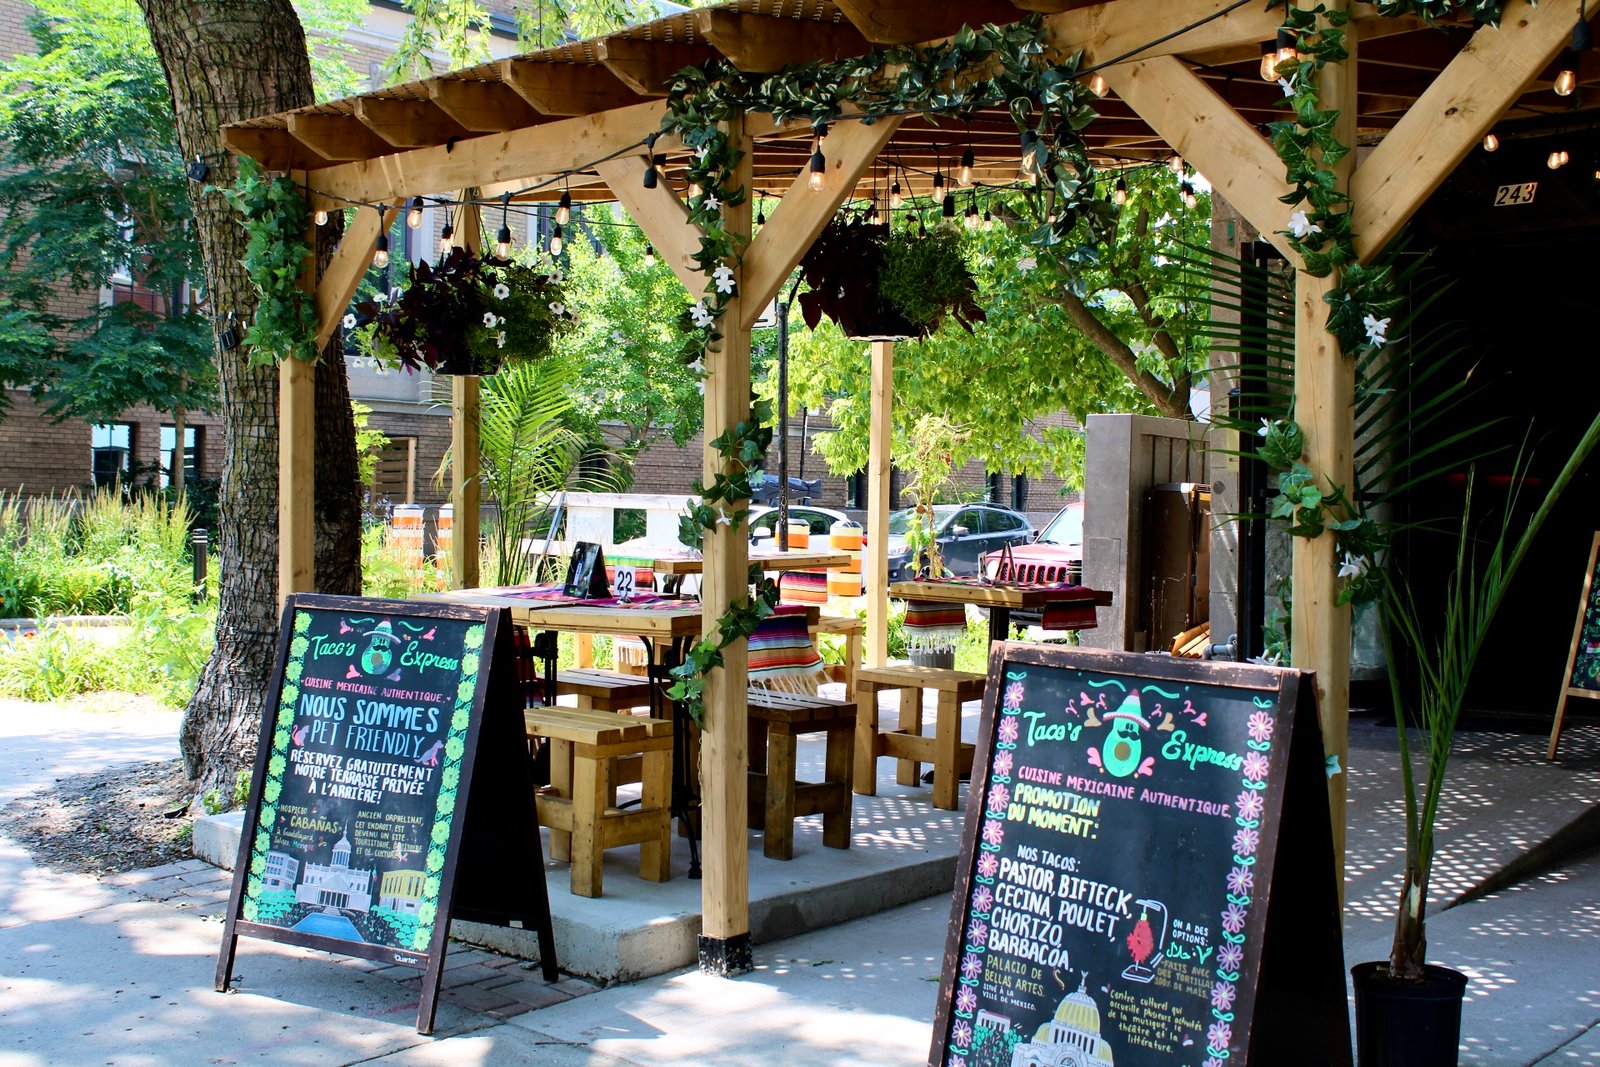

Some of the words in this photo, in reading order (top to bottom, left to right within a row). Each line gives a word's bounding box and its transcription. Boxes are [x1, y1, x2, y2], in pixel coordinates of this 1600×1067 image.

[1496, 184, 1535, 205] 243
[617, 570, 633, 592] 22
[311, 634, 356, 661] Taco's
[400, 641, 459, 673] Express
[305, 677, 333, 689] CUISINE
[336, 681, 378, 696] MEXICAINE
[300, 694, 347, 721] NOUS
[353, 699, 440, 734] SOMMES
[310, 719, 340, 746] PET
[1023, 711, 1082, 747] Taco's
[1162, 730, 1244, 771] Express
[290, 747, 342, 769] RÉSERVEZ
[346, 757, 434, 783] GRATUITEMENT
[294, 763, 327, 780] NOTRE
[331, 768, 378, 790] TERRASSE
[382, 777, 426, 796] PRIVÉE
[308, 776, 317, 794] À
[321, 782, 383, 805] L'ARRIÈRE!
[1018, 765, 1062, 786] CUISINE
[1066, 775, 1135, 800] MEXICAINE
[1013, 783, 1101, 818] PROMOTION
[355, 820, 366, 829] CET
[367, 822, 392, 831] ENDROIT
[394, 825, 405, 833] EST
[357, 810, 382, 819] ANCIEN
[1007, 803, 1026, 823] DU
[1028, 809, 1100, 839] MOMENT:
[354, 829, 378, 838] DEVENU
[381, 832, 390, 840] UN
[356, 847, 363, 855] ET
[1017, 844, 1038, 862] NOS
[1041, 850, 1081, 873] TACOS:
[999, 857, 1056, 898] PASTOR,
[1057, 874, 1133, 920] BIFTECK,
[995, 883, 1054, 921] CECINA,
[1058, 900, 1120, 943] POULET,
[991, 906, 1063, 949] CHORIZO,
[1172, 929, 1209, 947] OPTIONS:
[1173, 918, 1183, 929] ON
[1186, 922, 1191, 932] A
[1194, 925, 1209, 937] DES
[988, 929, 1074, 973] BARBACOA.
[986, 954, 1027, 975] PALACIO
[1031, 967, 1042, 980] DE
[1157, 968, 1172, 978] DES
[1176, 973, 1214, 990] TORTILLAS
[1191, 966, 1210, 978] AVEC
[984, 969, 1012, 988] BELLAS
[1015, 978, 1045, 997] ARTES.
[1173, 982, 1182, 991] DE
[982, 990, 998, 1001] VILLE
[1000, 995, 1008, 1004] DE
[1110, 989, 1135, 1003] Centre
[1140, 997, 1168, 1011] culturel
[1171, 1006, 1183, 1016] qui
[1110, 1000, 1140, 1015] accueille
[1107, 1009, 1116, 1019] de
[1120, 1012, 1127, 1021] la
[1132, 1015, 1168, 1031] musique,
[1174, 1024, 1182, 1032] le
[1119, 1022, 1150, 1036] théâtre
[1155, 1030, 1166, 1039] et
[1169, 1032, 1178, 1042] la
[1127, 1033, 1174, 1054] littérature.
